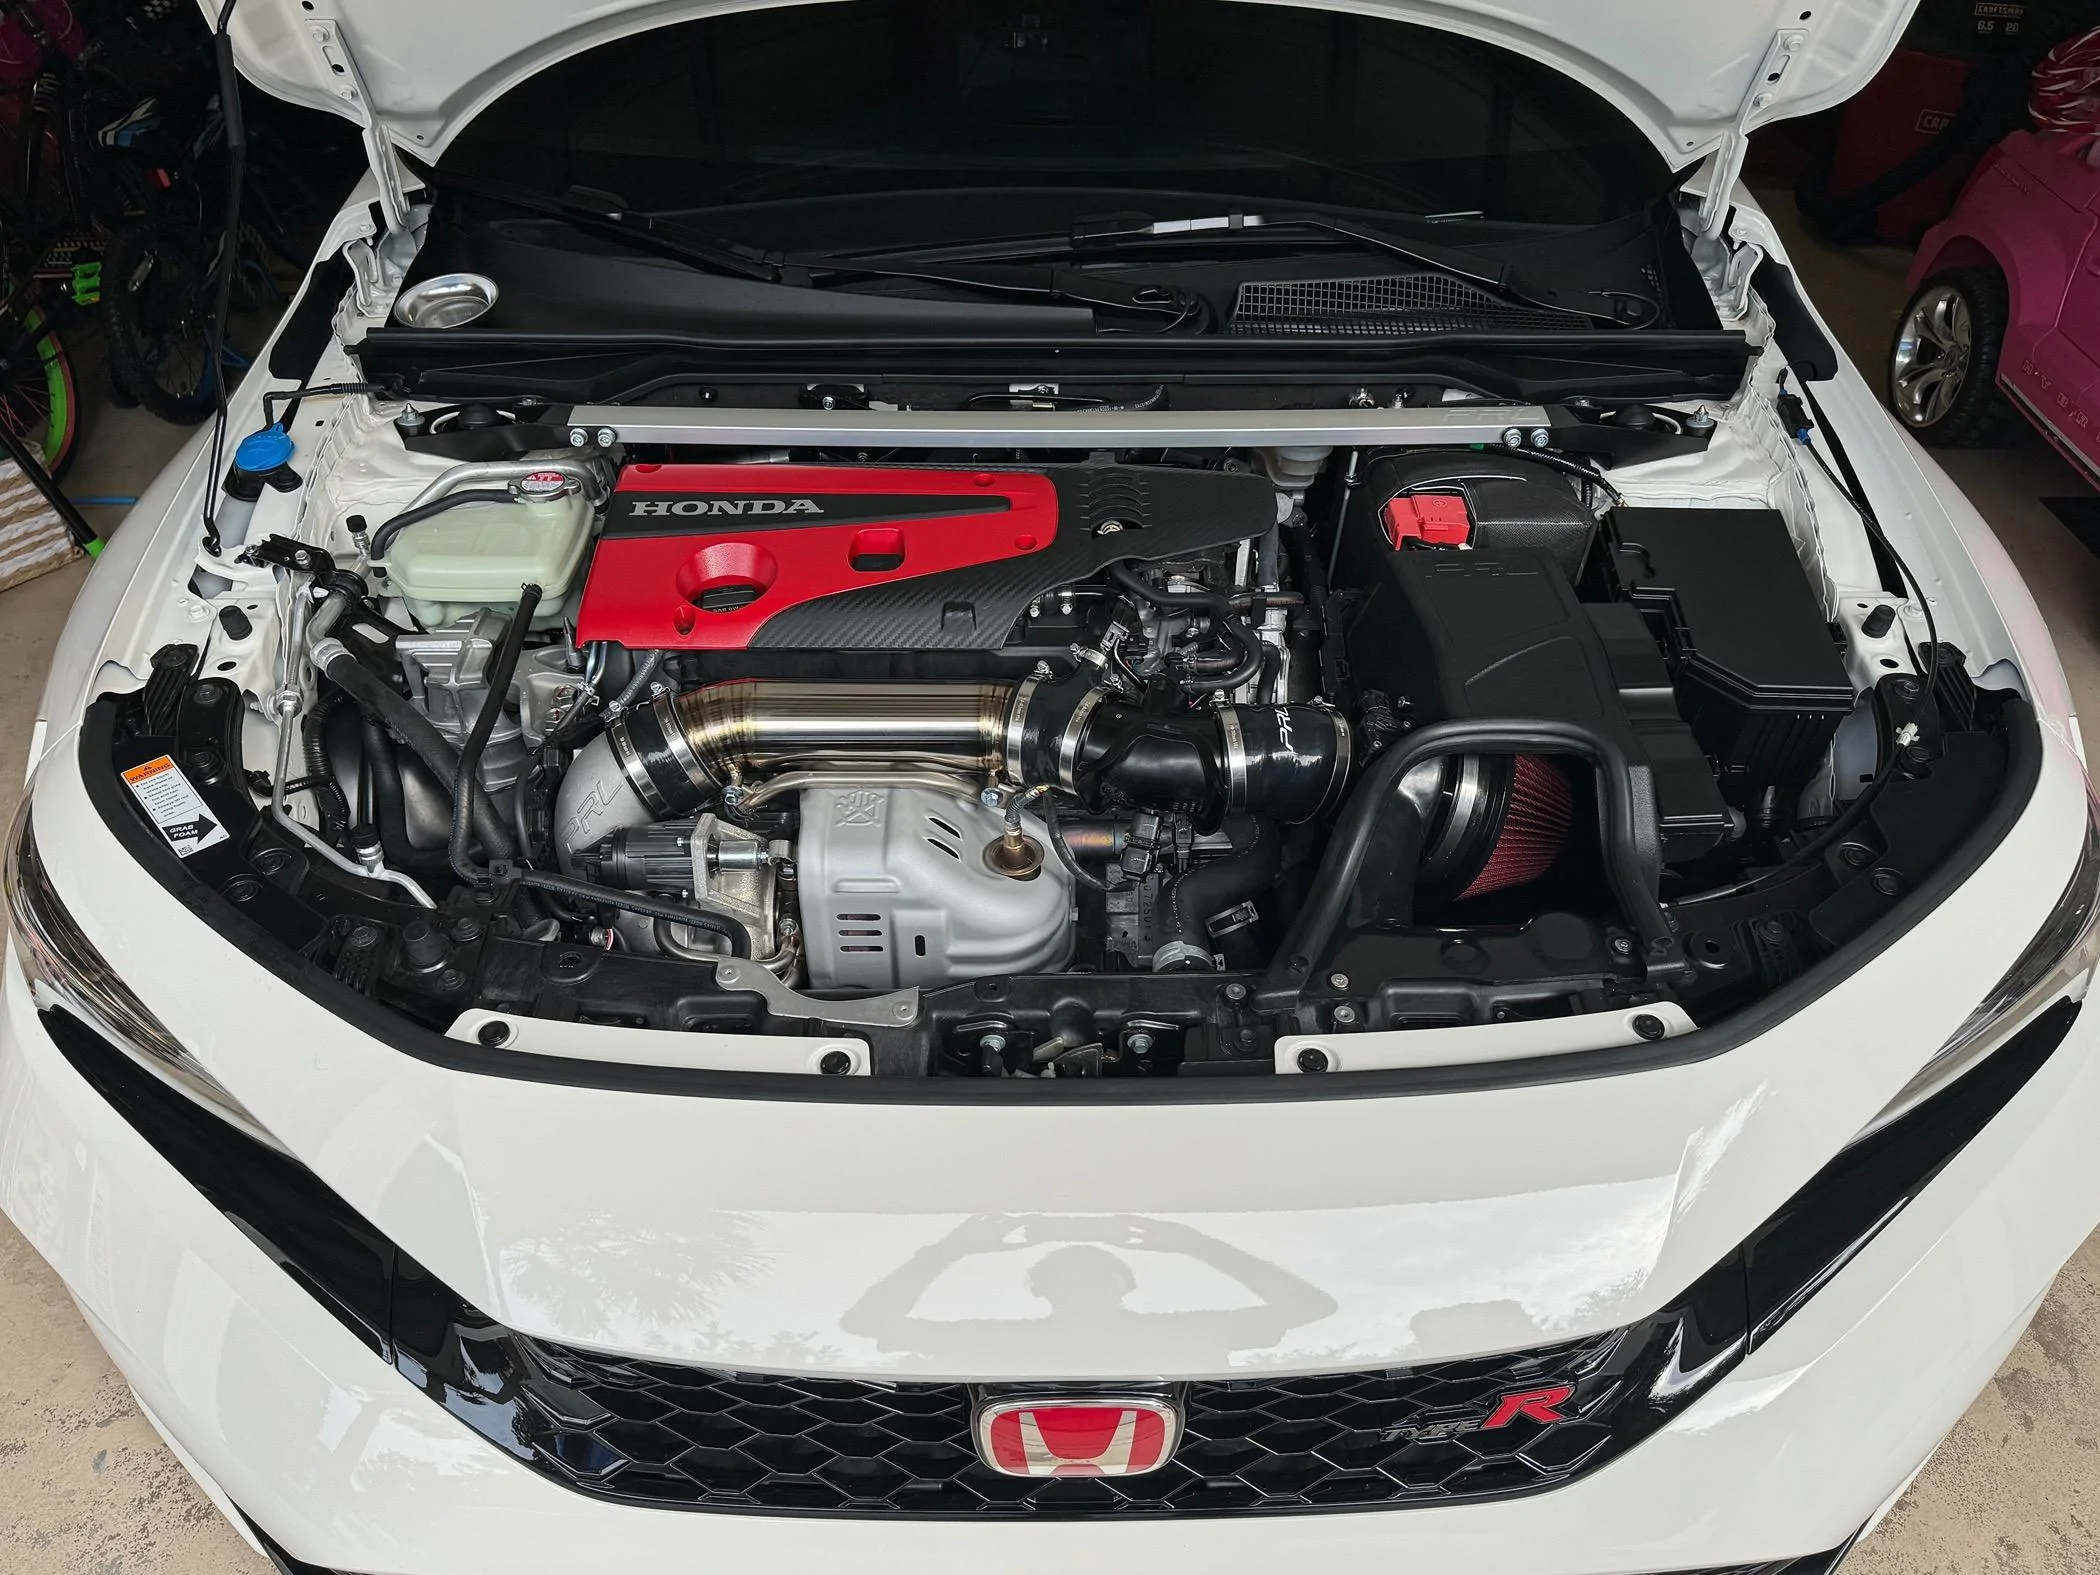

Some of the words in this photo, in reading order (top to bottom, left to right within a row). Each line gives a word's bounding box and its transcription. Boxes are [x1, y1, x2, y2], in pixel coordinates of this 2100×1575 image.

[629, 498, 825, 516] HONDA
[1274, 706, 1294, 753] PRL
[129, 761, 171, 782] WARNING
[560, 779, 624, 855] PRL
[169, 824, 194, 833] GRAB
[173, 829, 198, 839] FOAM
[1378, 1418, 1482, 1442] TYPE
[1480, 1382, 1576, 1430] R
